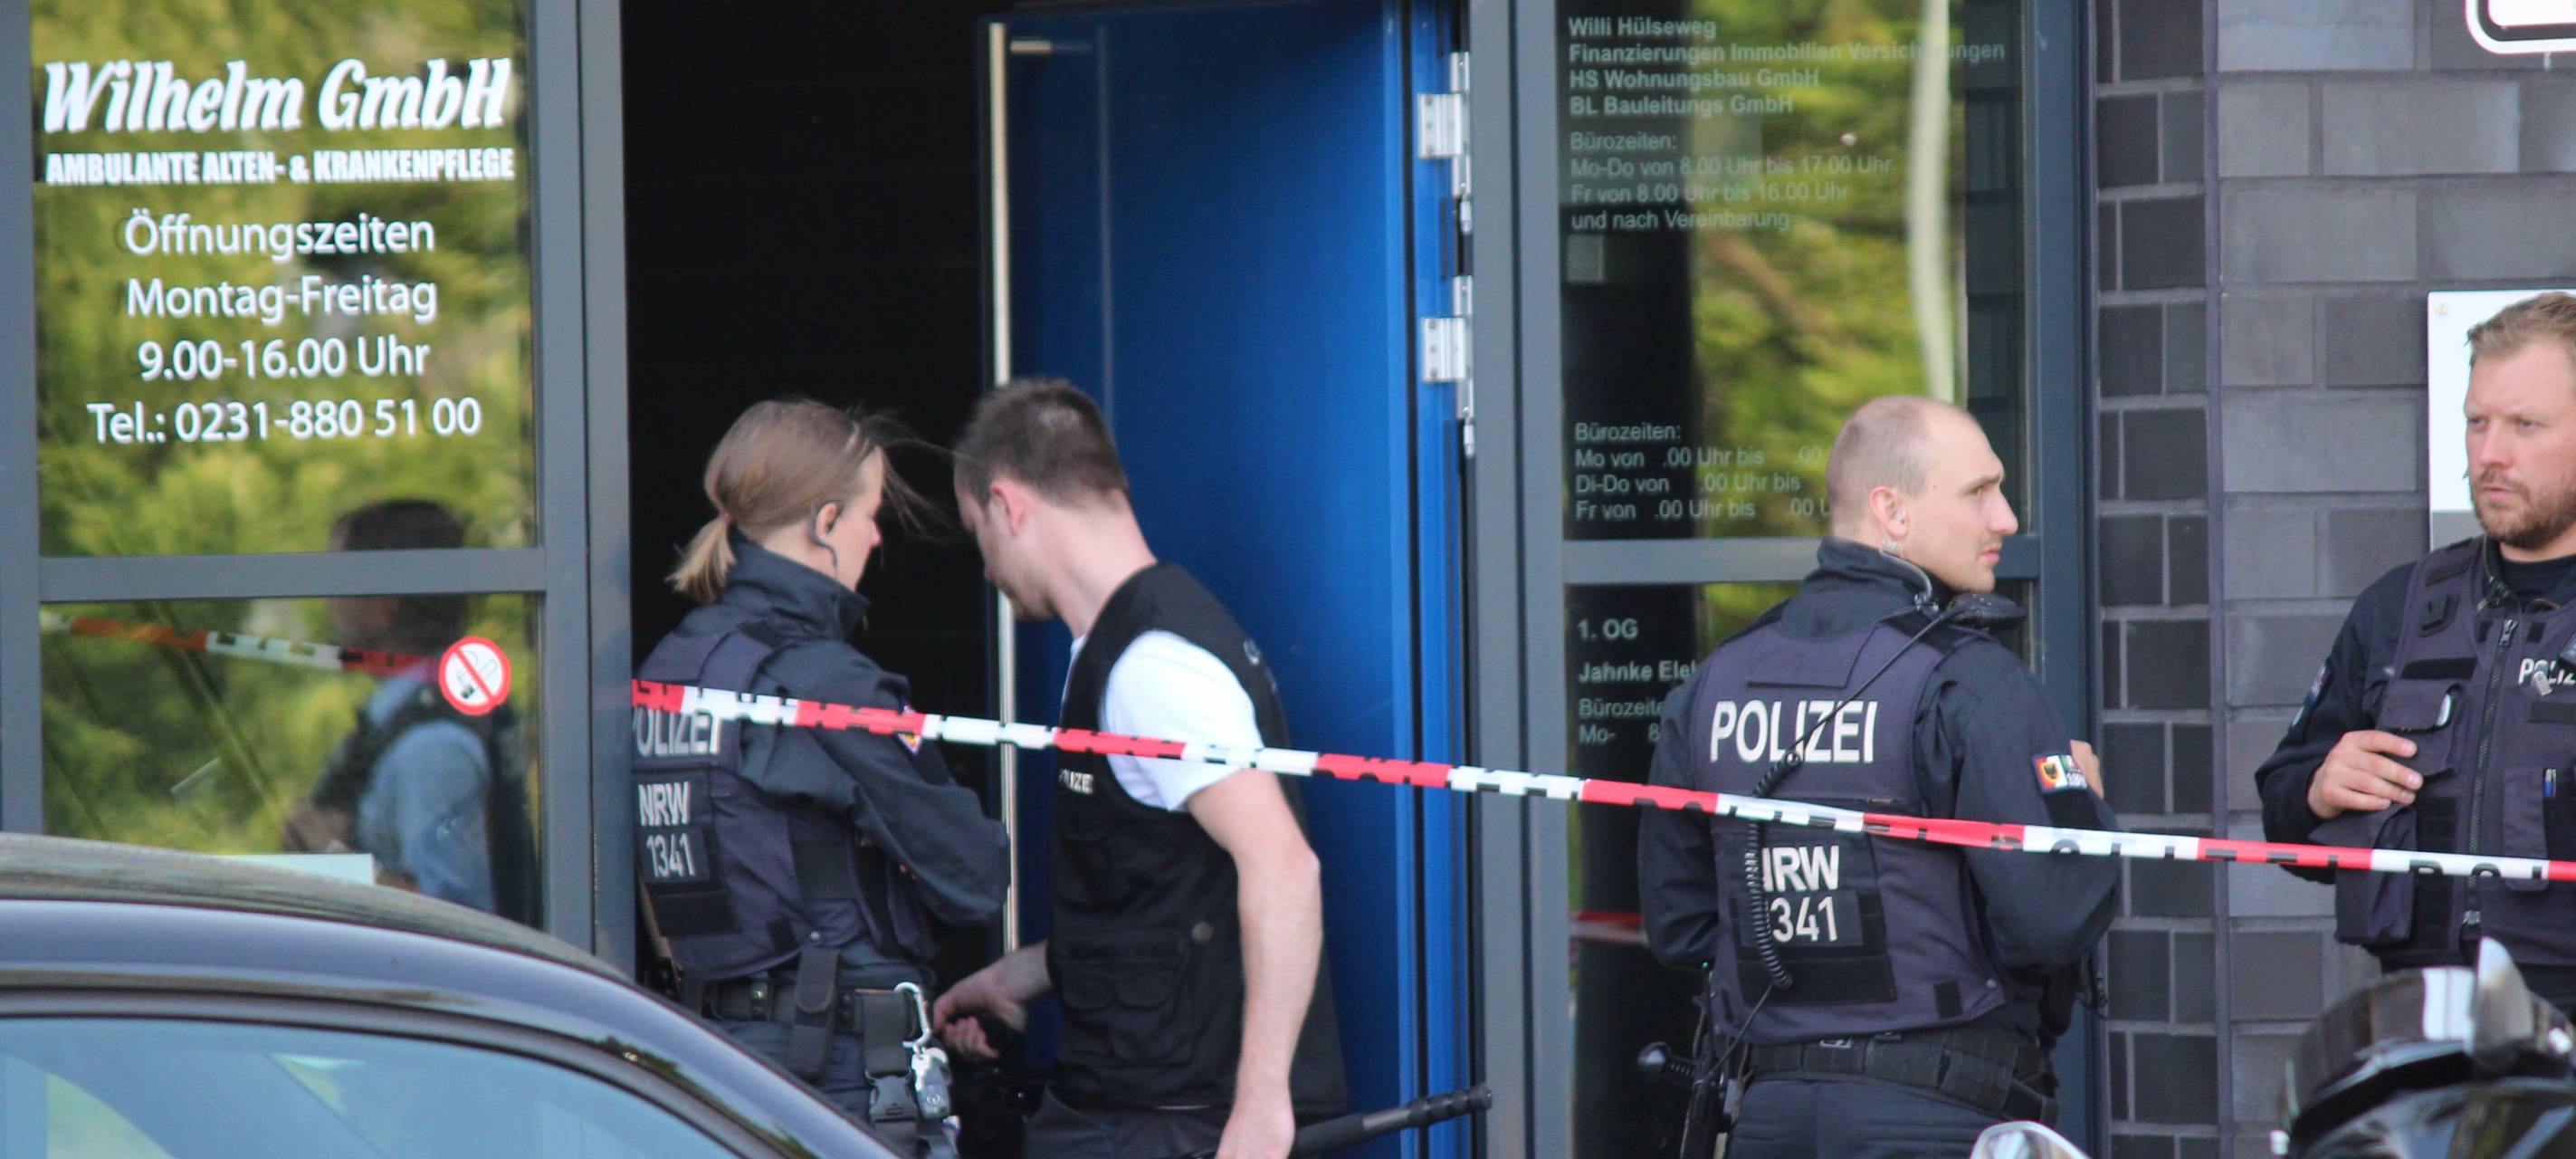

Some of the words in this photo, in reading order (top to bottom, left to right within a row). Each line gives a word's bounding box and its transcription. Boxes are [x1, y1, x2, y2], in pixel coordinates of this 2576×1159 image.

[1569, 16, 1611, 35] Willi
[1617, 16, 1716, 39] Hülseweg
[1569, 43, 1724, 64] Finanzierungen
[1731, 42, 1841, 62] Immobilien
[1569, 70, 1598, 88] HS
[1604, 69, 1750, 91] Wohnungsbau
[1758, 68, 1818, 87] GmbH
[43, 59, 305, 133] Wilhelm
[318, 57, 512, 130] GmbH
[1570, 96, 1598, 115] BL
[1604, 95, 1723, 117] Bauleitungs
[1731, 93, 1793, 112] GmbH
[1571, 131, 1677, 150] Bürozeiten:
[46, 151, 200, 185] AMBULANTE
[202, 150, 287, 183] ALTEN-
[289, 154, 310, 183] &
[313, 148, 515, 181] KRANKENPFLEGE
[1571, 158, 1634, 177] Mo-Do
[1640, 161, 1674, 176] von
[1680, 156, 1720, 175] 8.00
[1727, 157, 1761, 175] Uhr
[1767, 156, 1794, 174] bis
[1857, 155, 1892, 174] Uhr
[1571, 184, 1592, 203] Fr
[1598, 187, 1630, 202] von
[1637, 183, 1677, 202] 8.00
[1684, 183, 1717, 202] Uhr
[1723, 182, 1751, 201] bis
[1815, 182, 1848, 200] Uhr
[1571, 211, 1607, 229] und
[1613, 210, 1658, 229] nach
[1664, 209, 1789, 232] Vereinbarung
[125, 207, 435, 262] Öffnungszeiten
[127, 275, 438, 325] Montag-Freitag
[138, 339, 346, 381] 9.00-16.00
[358, 335, 431, 377] Uhr
[87, 401, 166, 444] Tel.:
[175, 398, 364, 443] 0231-880
[375, 398, 417, 436] 51
[432, 397, 482, 436] 00
[1575, 422, 1681, 442] Bürozeiten:
[1576, 448, 1605, 467] Mo
[1611, 452, 1645, 467] von
[1697, 446, 1731, 465] Uhr
[1736, 445, 1764, 465] bis
[1576, 474, 1630, 493] Di-Do
[1635, 477, 1669, 493] von
[1733, 473, 1768, 492] Uhr
[1773, 472, 1800, 492] bis
[1576, 500, 1597, 520] Fr
[1602, 503, 1636, 519] von
[1689, 499, 1722, 519] Uhr
[1728, 499, 1755, 518] bis
[1578, 618, 1597, 639] 1.
[1602, 618, 1638, 640] OG
[1579, 661, 1653, 683] Jahnke
[1710, 700, 1878, 763] POLIZEI
[638, 781, 691, 827] NRW
[646, 832, 696, 877] 1341
[1769, 896, 1837, 943] 341
